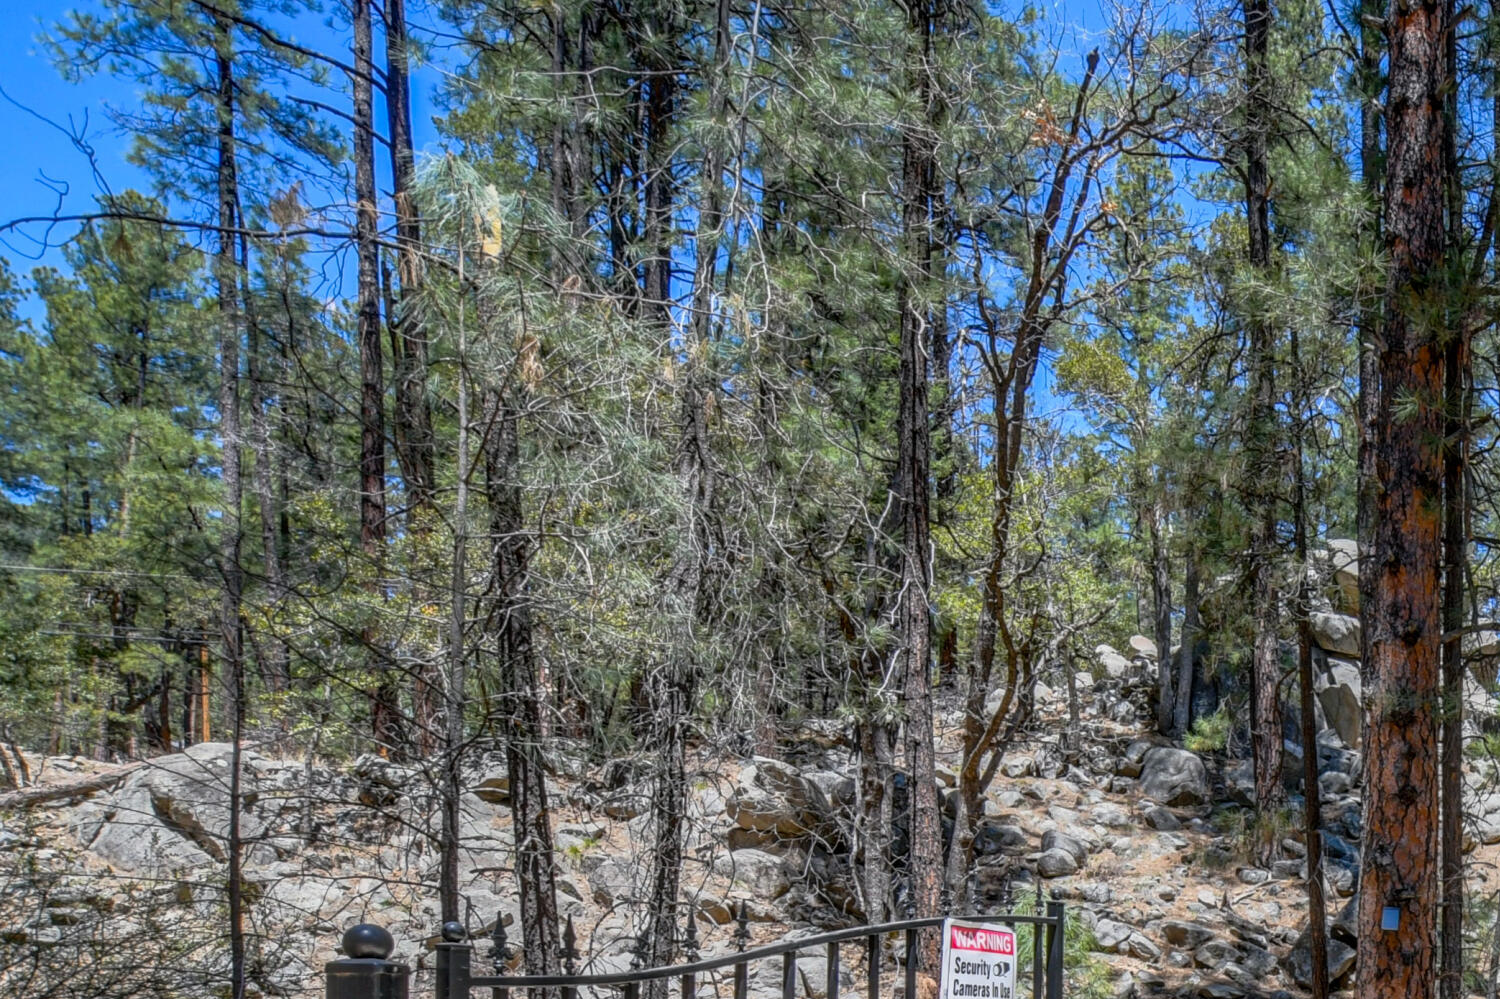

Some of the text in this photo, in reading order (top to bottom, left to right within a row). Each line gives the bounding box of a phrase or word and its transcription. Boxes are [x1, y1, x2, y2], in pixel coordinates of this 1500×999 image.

[954, 929, 1011, 952] WARNING
[954, 956, 991, 980] Security
[953, 978, 1011, 999] Cameras In Use
